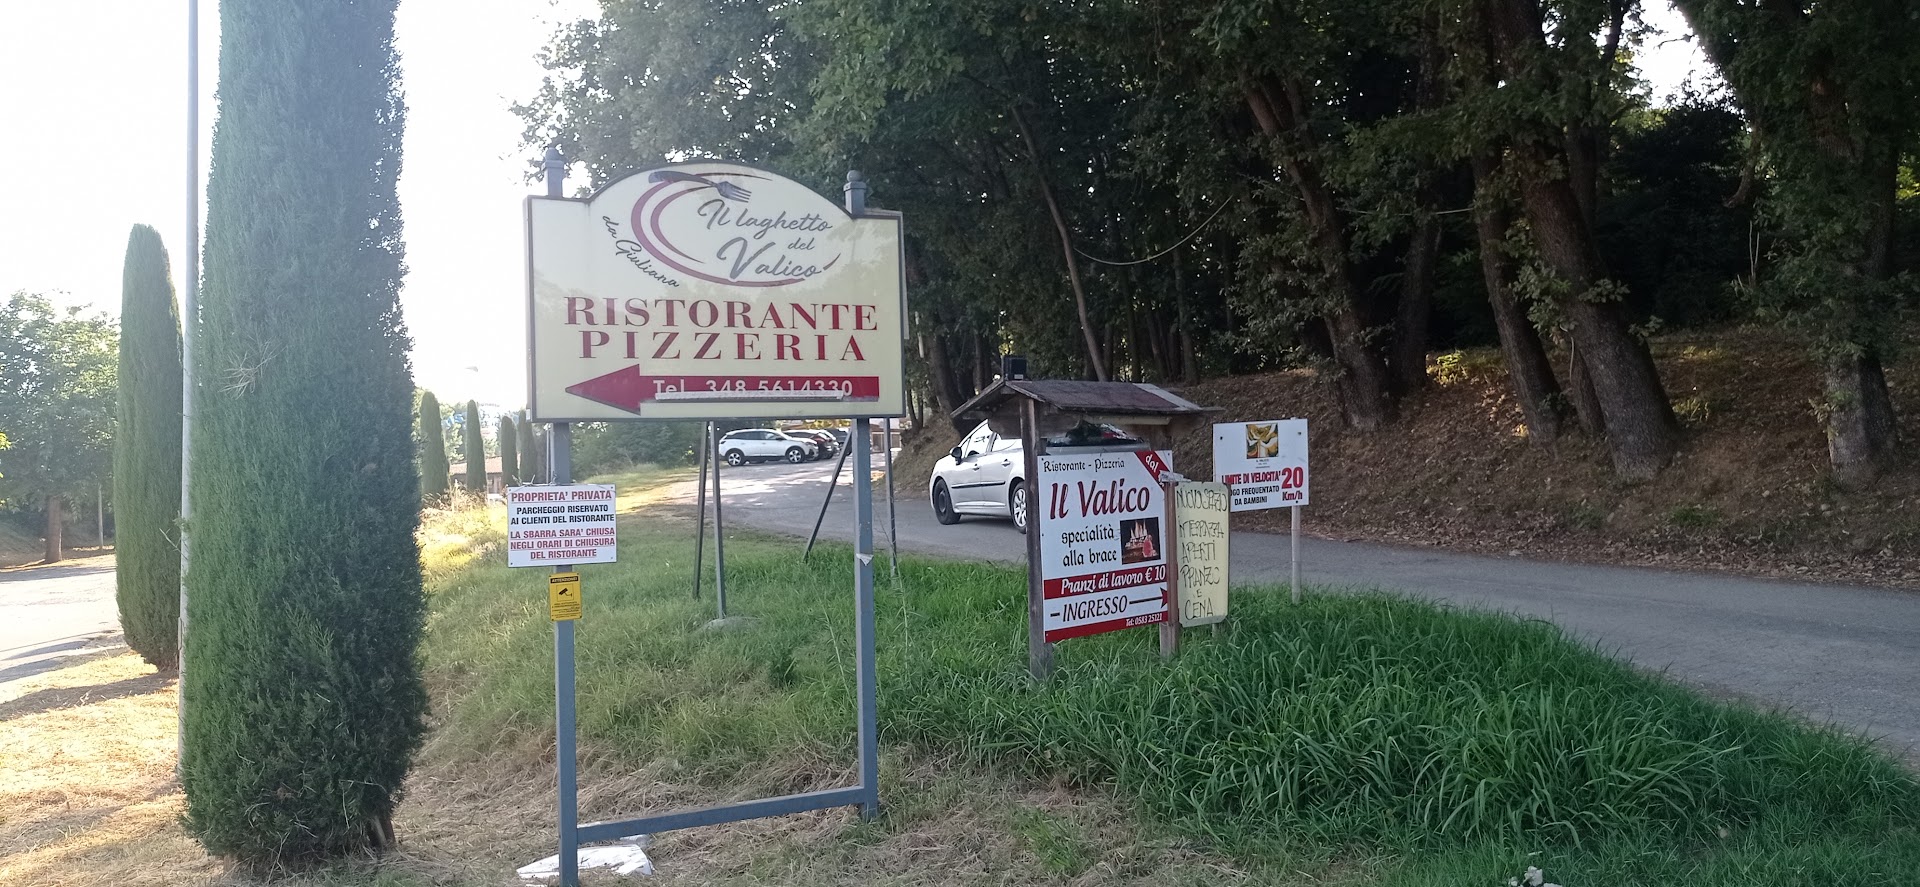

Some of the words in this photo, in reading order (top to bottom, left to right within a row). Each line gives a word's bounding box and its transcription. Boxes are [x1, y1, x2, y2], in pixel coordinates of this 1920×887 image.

[696, 198, 731, 230] Il
[735, 207, 833, 240] laghetto
[602, 215, 619, 239] da
[615, 239, 680, 288] Giuliana
[787, 237, 815, 251] del
[716, 236, 822, 280] Valico
[564, 296, 878, 331] RISTORANTE
[578, 330, 867, 361] PIZZERIA
[705, 380, 747, 394] 348
[1043, 460, 1086, 472] Ristorante
[1094, 458, 1125, 473] Pizzeria
[1145, 453, 1159, 473] dal
[1243, 473, 1250, 484] DI
[1281, 466, 1304, 489] 20
[511, 491, 568, 502] PROPRIETA'
[571, 490, 612, 500] PRIVATA
[1241, 485, 1280, 496] FREQUENTATO
[1282, 490, 1303, 501] Km/h
[1050, 482, 1069, 520] Il
[1077, 478, 1150, 517] Valico
[1234, 498, 1242, 506] DA
[1243, 496, 1268, 505] BAMBINI
[516, 505, 565, 515] PARCHEGGIO
[567, 504, 608, 513] RISERVATO
[511, 517, 519, 525] AI
[521, 516, 550, 525] CLIENTI
[552, 515, 567, 524] DEL
[569, 514, 615, 523] RISTORANTE
[510, 531, 521, 539] LA
[523, 529, 557, 538] SBARRA
[559, 528, 583, 537] SARA'
[586, 527, 615, 536] CHIUSA
[1061, 524, 1115, 548] specialità
[510, 541, 534, 550] NEGLI
[537, 540, 562, 549] ORARI
[564, 539, 573, 547] DI
[575, 537, 615, 547] CHIUSURA
[530, 551, 546, 560] DEL
[548, 549, 597, 558] RISTORANTE
[1062, 549, 1084, 567] alla
[1088, 548, 1117, 564] brace
[1061, 575, 1096, 595] Pranzi
[1098, 573, 1109, 589] di
[1111, 571, 1143, 589] lavoro
[1145, 567, 1152, 583] €
[1154, 565, 1166, 581] 10
[1196, 588, 1202, 598] E
[1062, 595, 1128, 622] INGRESSO
[1184, 598, 1214, 620] CENA
